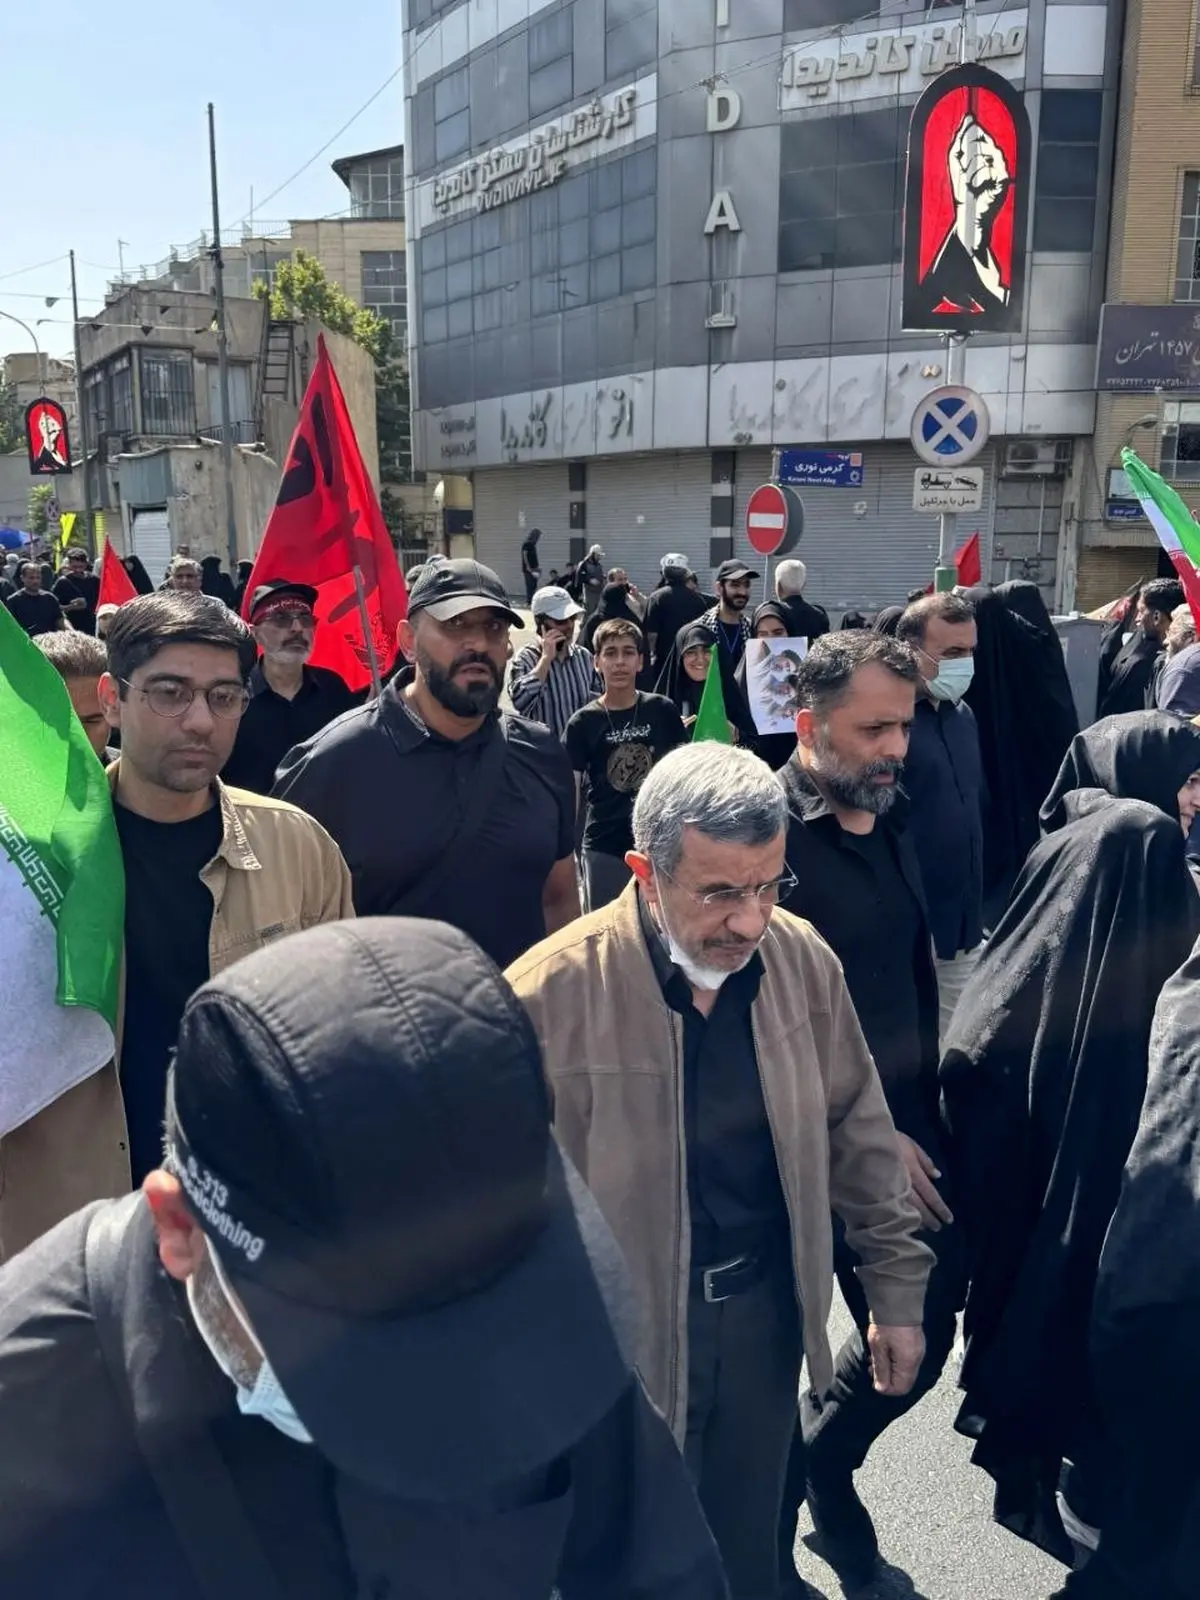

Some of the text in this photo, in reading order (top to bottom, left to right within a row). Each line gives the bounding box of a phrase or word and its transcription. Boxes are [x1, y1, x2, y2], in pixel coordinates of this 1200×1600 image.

[1115, 331, 1160, 365] تهران
[794, 462, 845, 474] کرمی نوری
